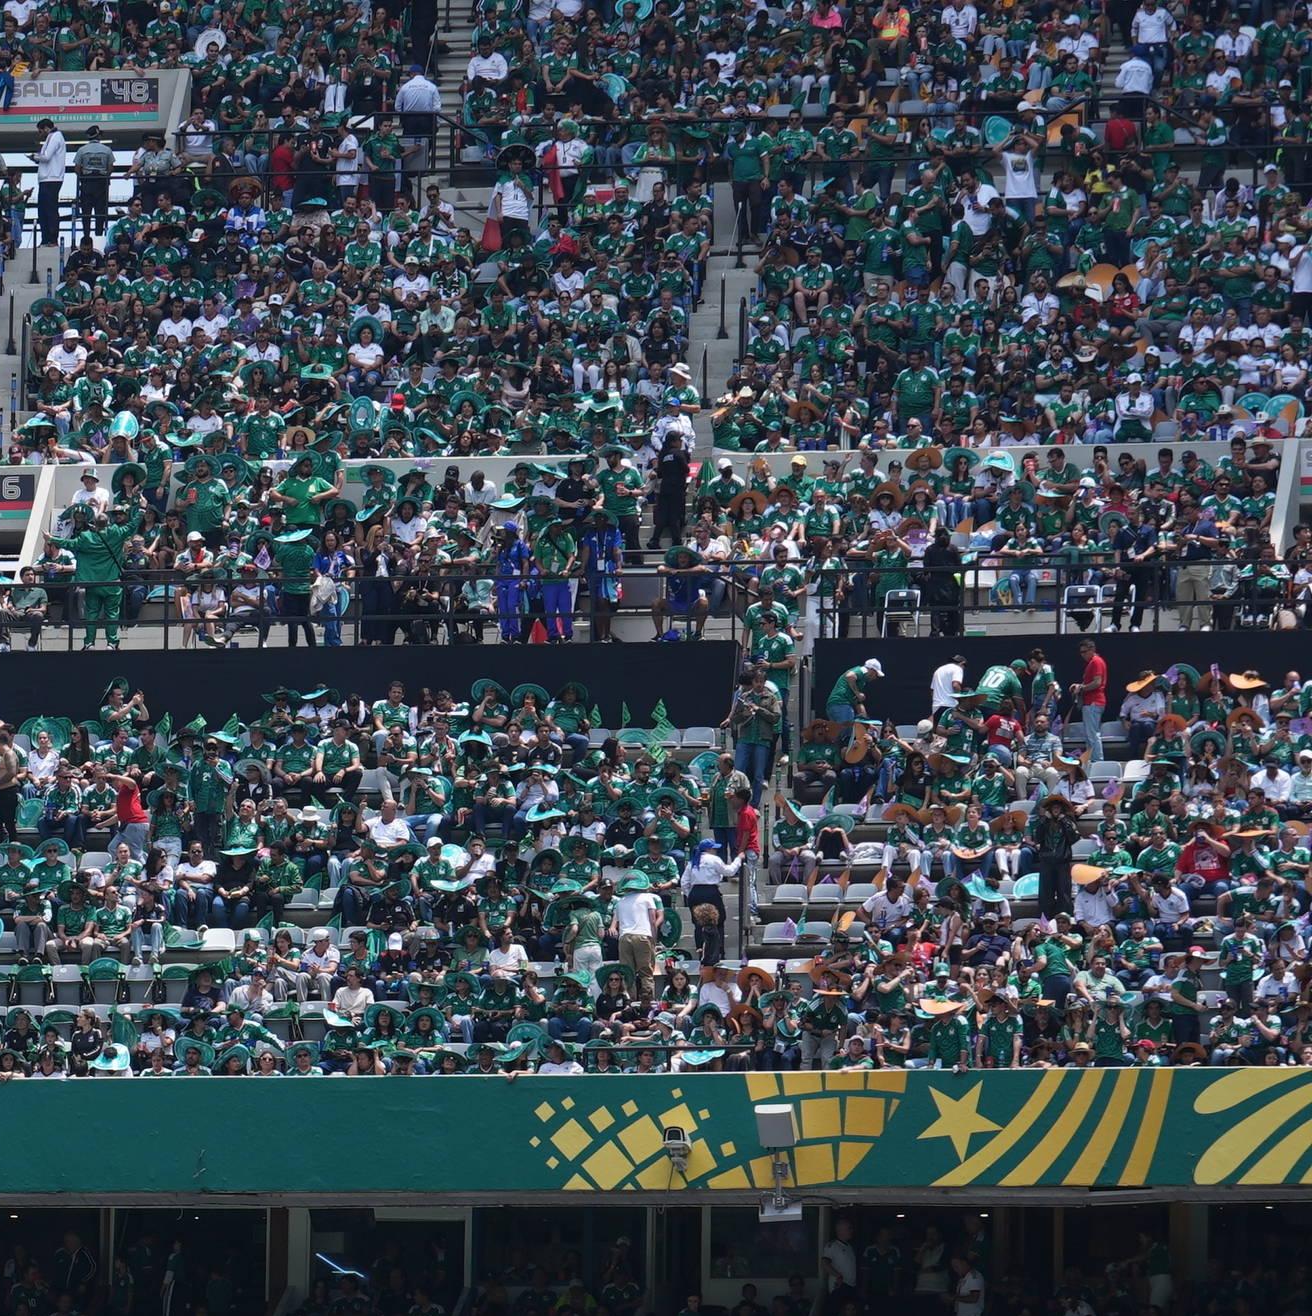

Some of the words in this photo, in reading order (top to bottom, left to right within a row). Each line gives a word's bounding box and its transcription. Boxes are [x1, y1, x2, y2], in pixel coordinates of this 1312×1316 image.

[13, 81, 91, 98] SALIDA
[110, 80, 149, 103] 48
[2, 475, 21, 500] 6
[981, 670, 1006, 689] 10
